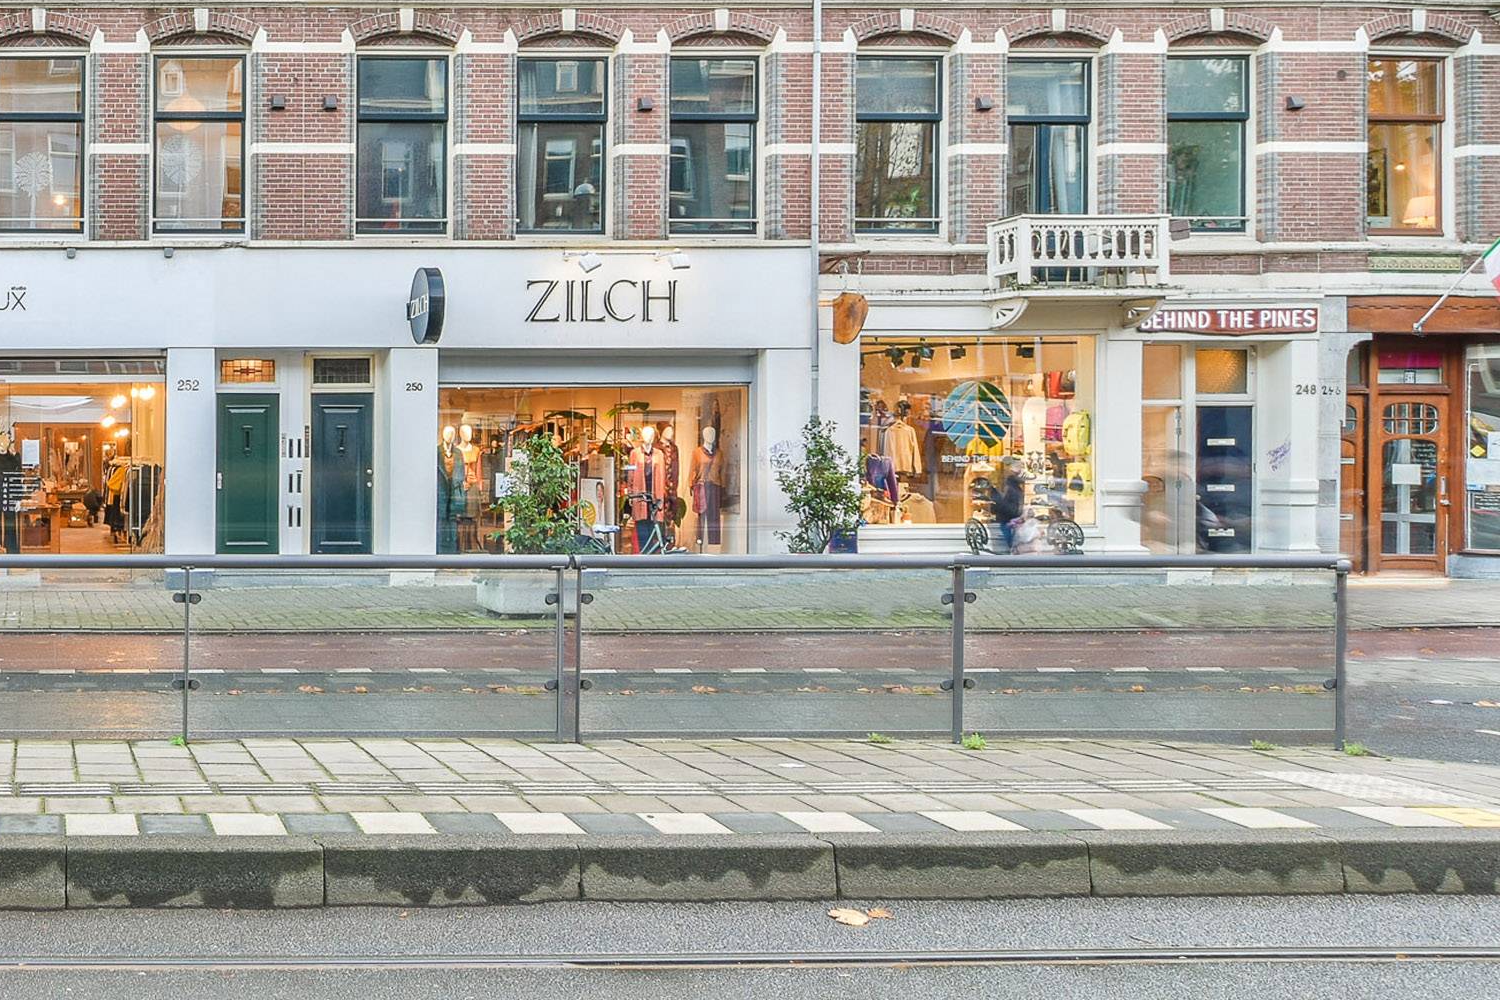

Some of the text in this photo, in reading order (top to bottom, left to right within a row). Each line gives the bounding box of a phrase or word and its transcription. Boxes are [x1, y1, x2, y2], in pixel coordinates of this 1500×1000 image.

[525, 279, 679, 323] ZILCH
[1217, 310, 1255, 328] THE
[1260, 309, 1316, 328] PINES
[177, 380, 199, 391] 252
[405, 382, 423, 391] 250
[1295, 384, 1317, 395] 248
